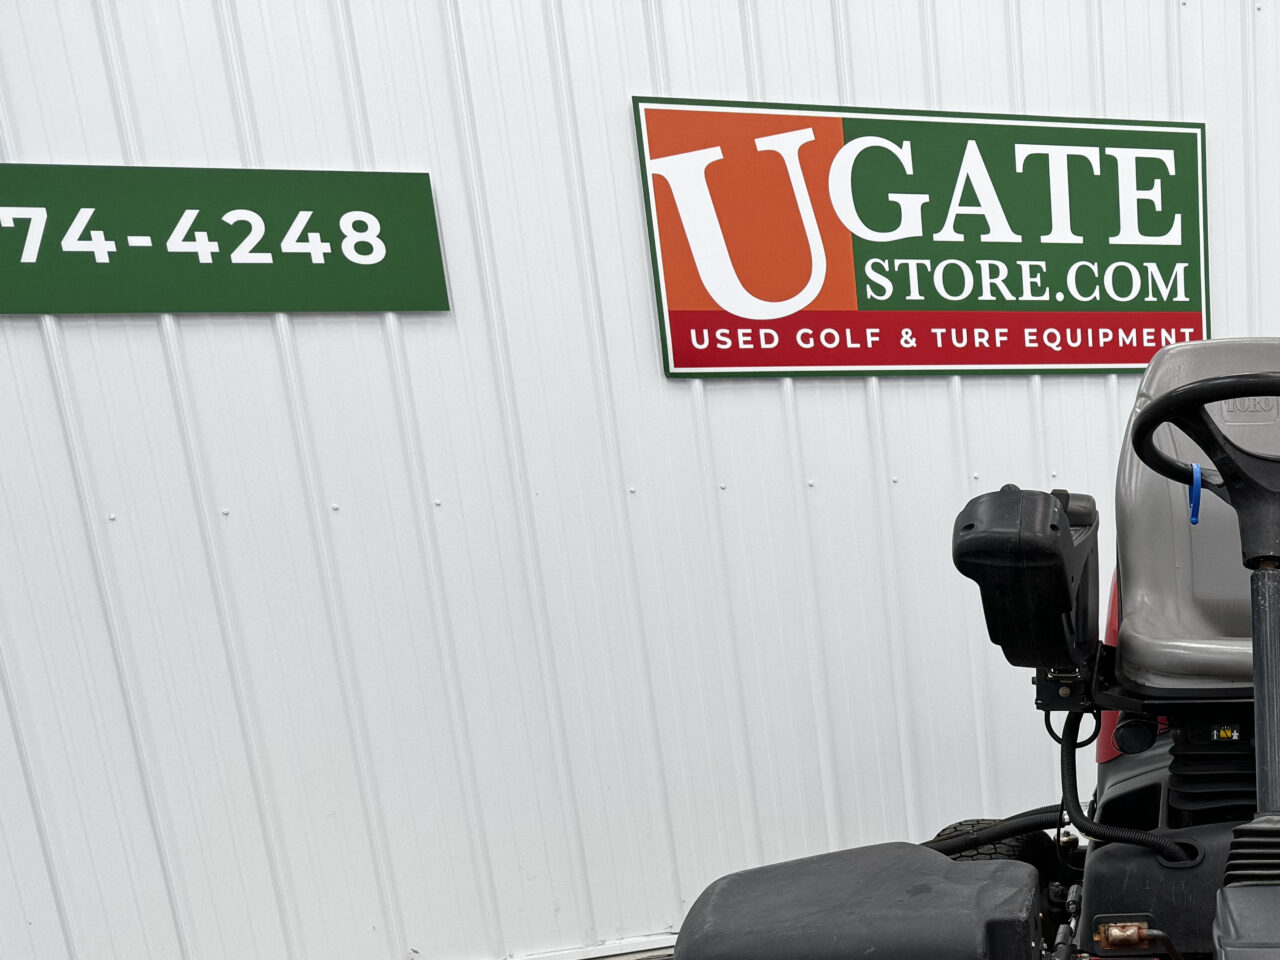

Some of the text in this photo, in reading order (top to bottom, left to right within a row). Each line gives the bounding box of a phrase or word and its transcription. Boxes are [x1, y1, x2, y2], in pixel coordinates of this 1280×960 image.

[0, 206, 388, 265] 74-4248
[865, 257, 1190, 303] STORE.COM
[690, 327, 1195, 351] USED GOLF & TURF EQUIPMENT
